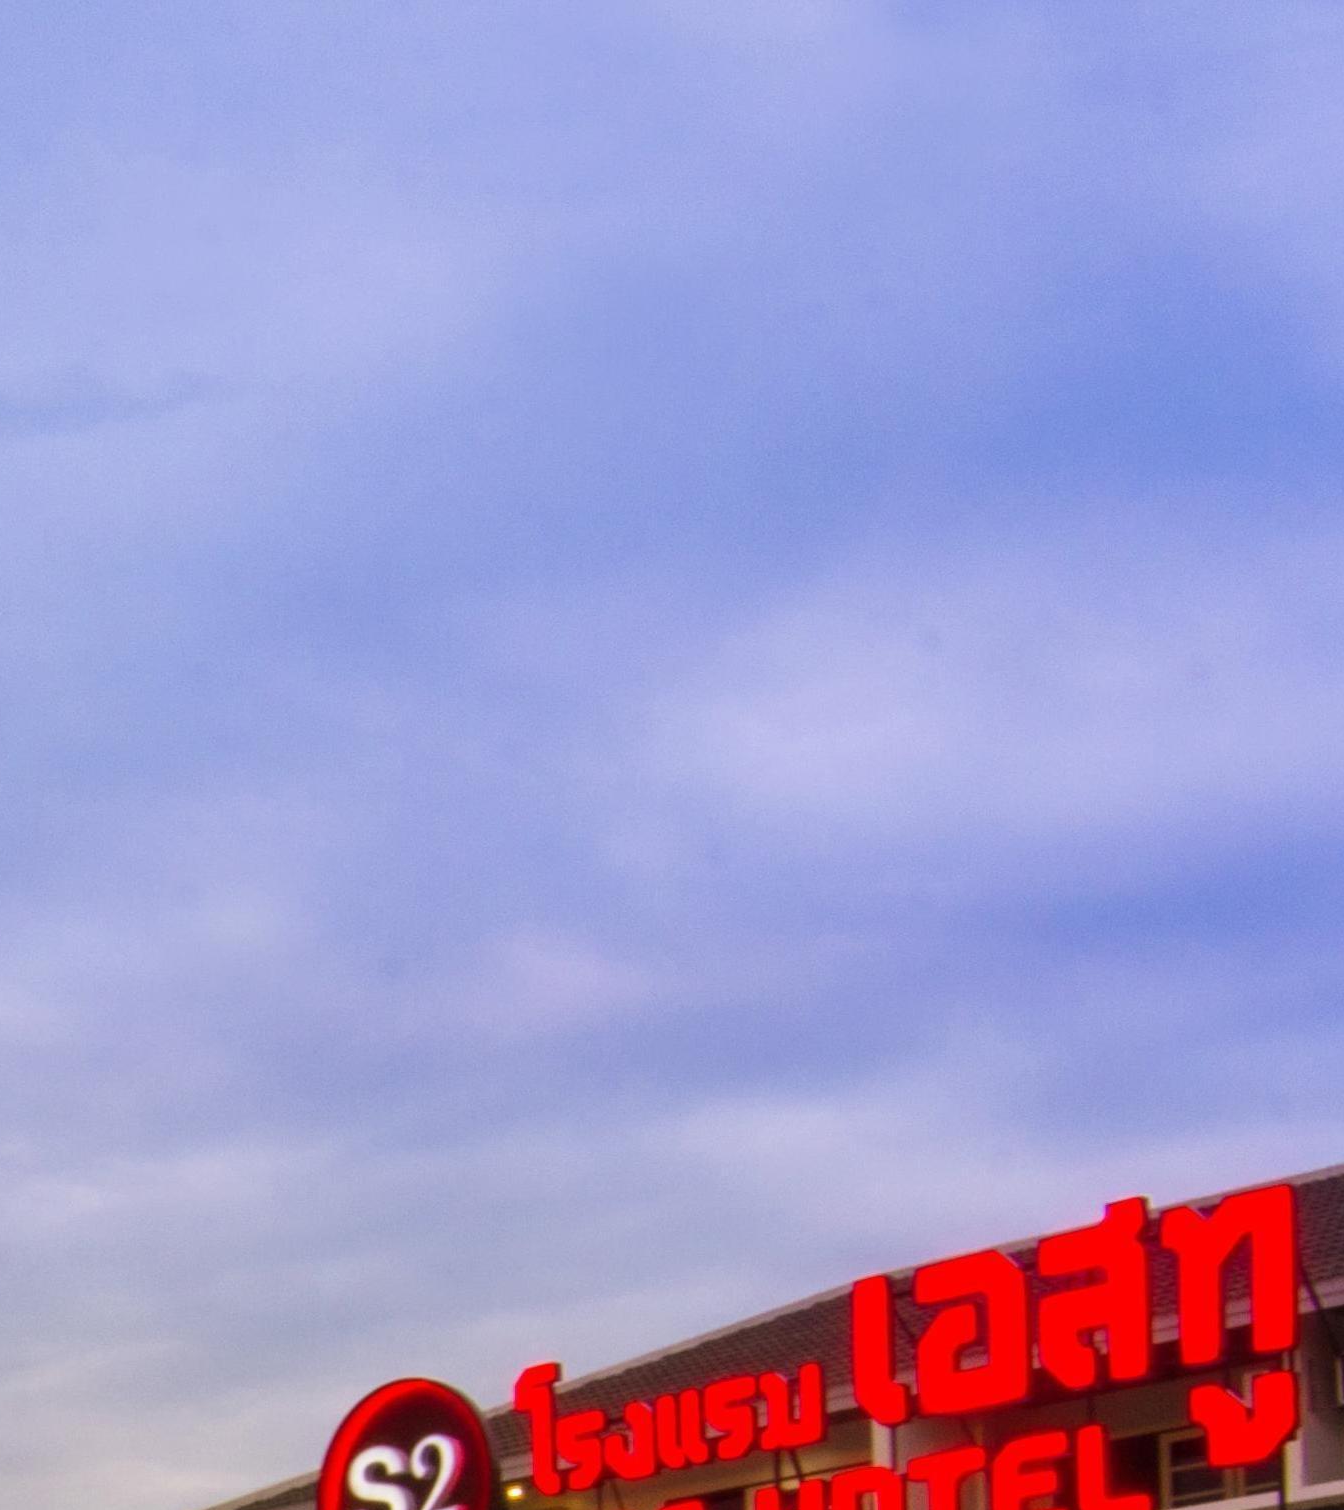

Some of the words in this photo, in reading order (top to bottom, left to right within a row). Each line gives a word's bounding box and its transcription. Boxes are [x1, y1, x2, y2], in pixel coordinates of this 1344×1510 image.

[514, 1362, 827, 1496] โรงแรม
[852, 1183, 1299, 1468] เอสทู
